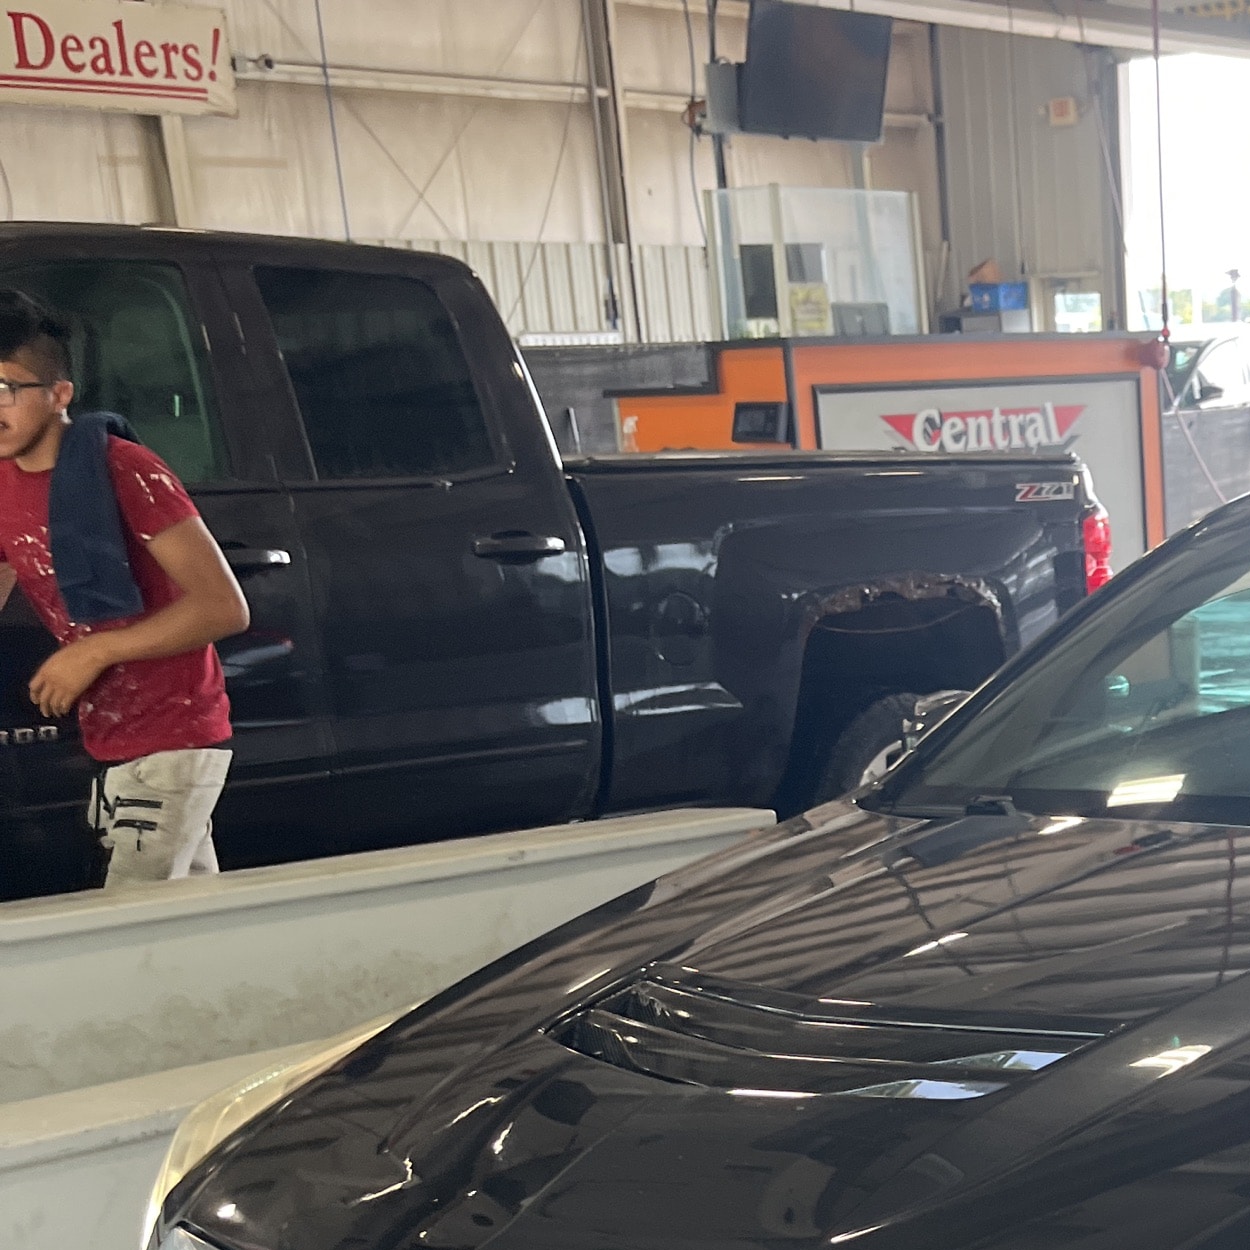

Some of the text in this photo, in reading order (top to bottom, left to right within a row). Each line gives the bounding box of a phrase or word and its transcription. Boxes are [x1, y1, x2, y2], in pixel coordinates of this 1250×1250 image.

[7, 10, 220, 82] Dealers!
[912, 401, 1063, 453] Central
[1015, 482, 1075, 502] Z71
